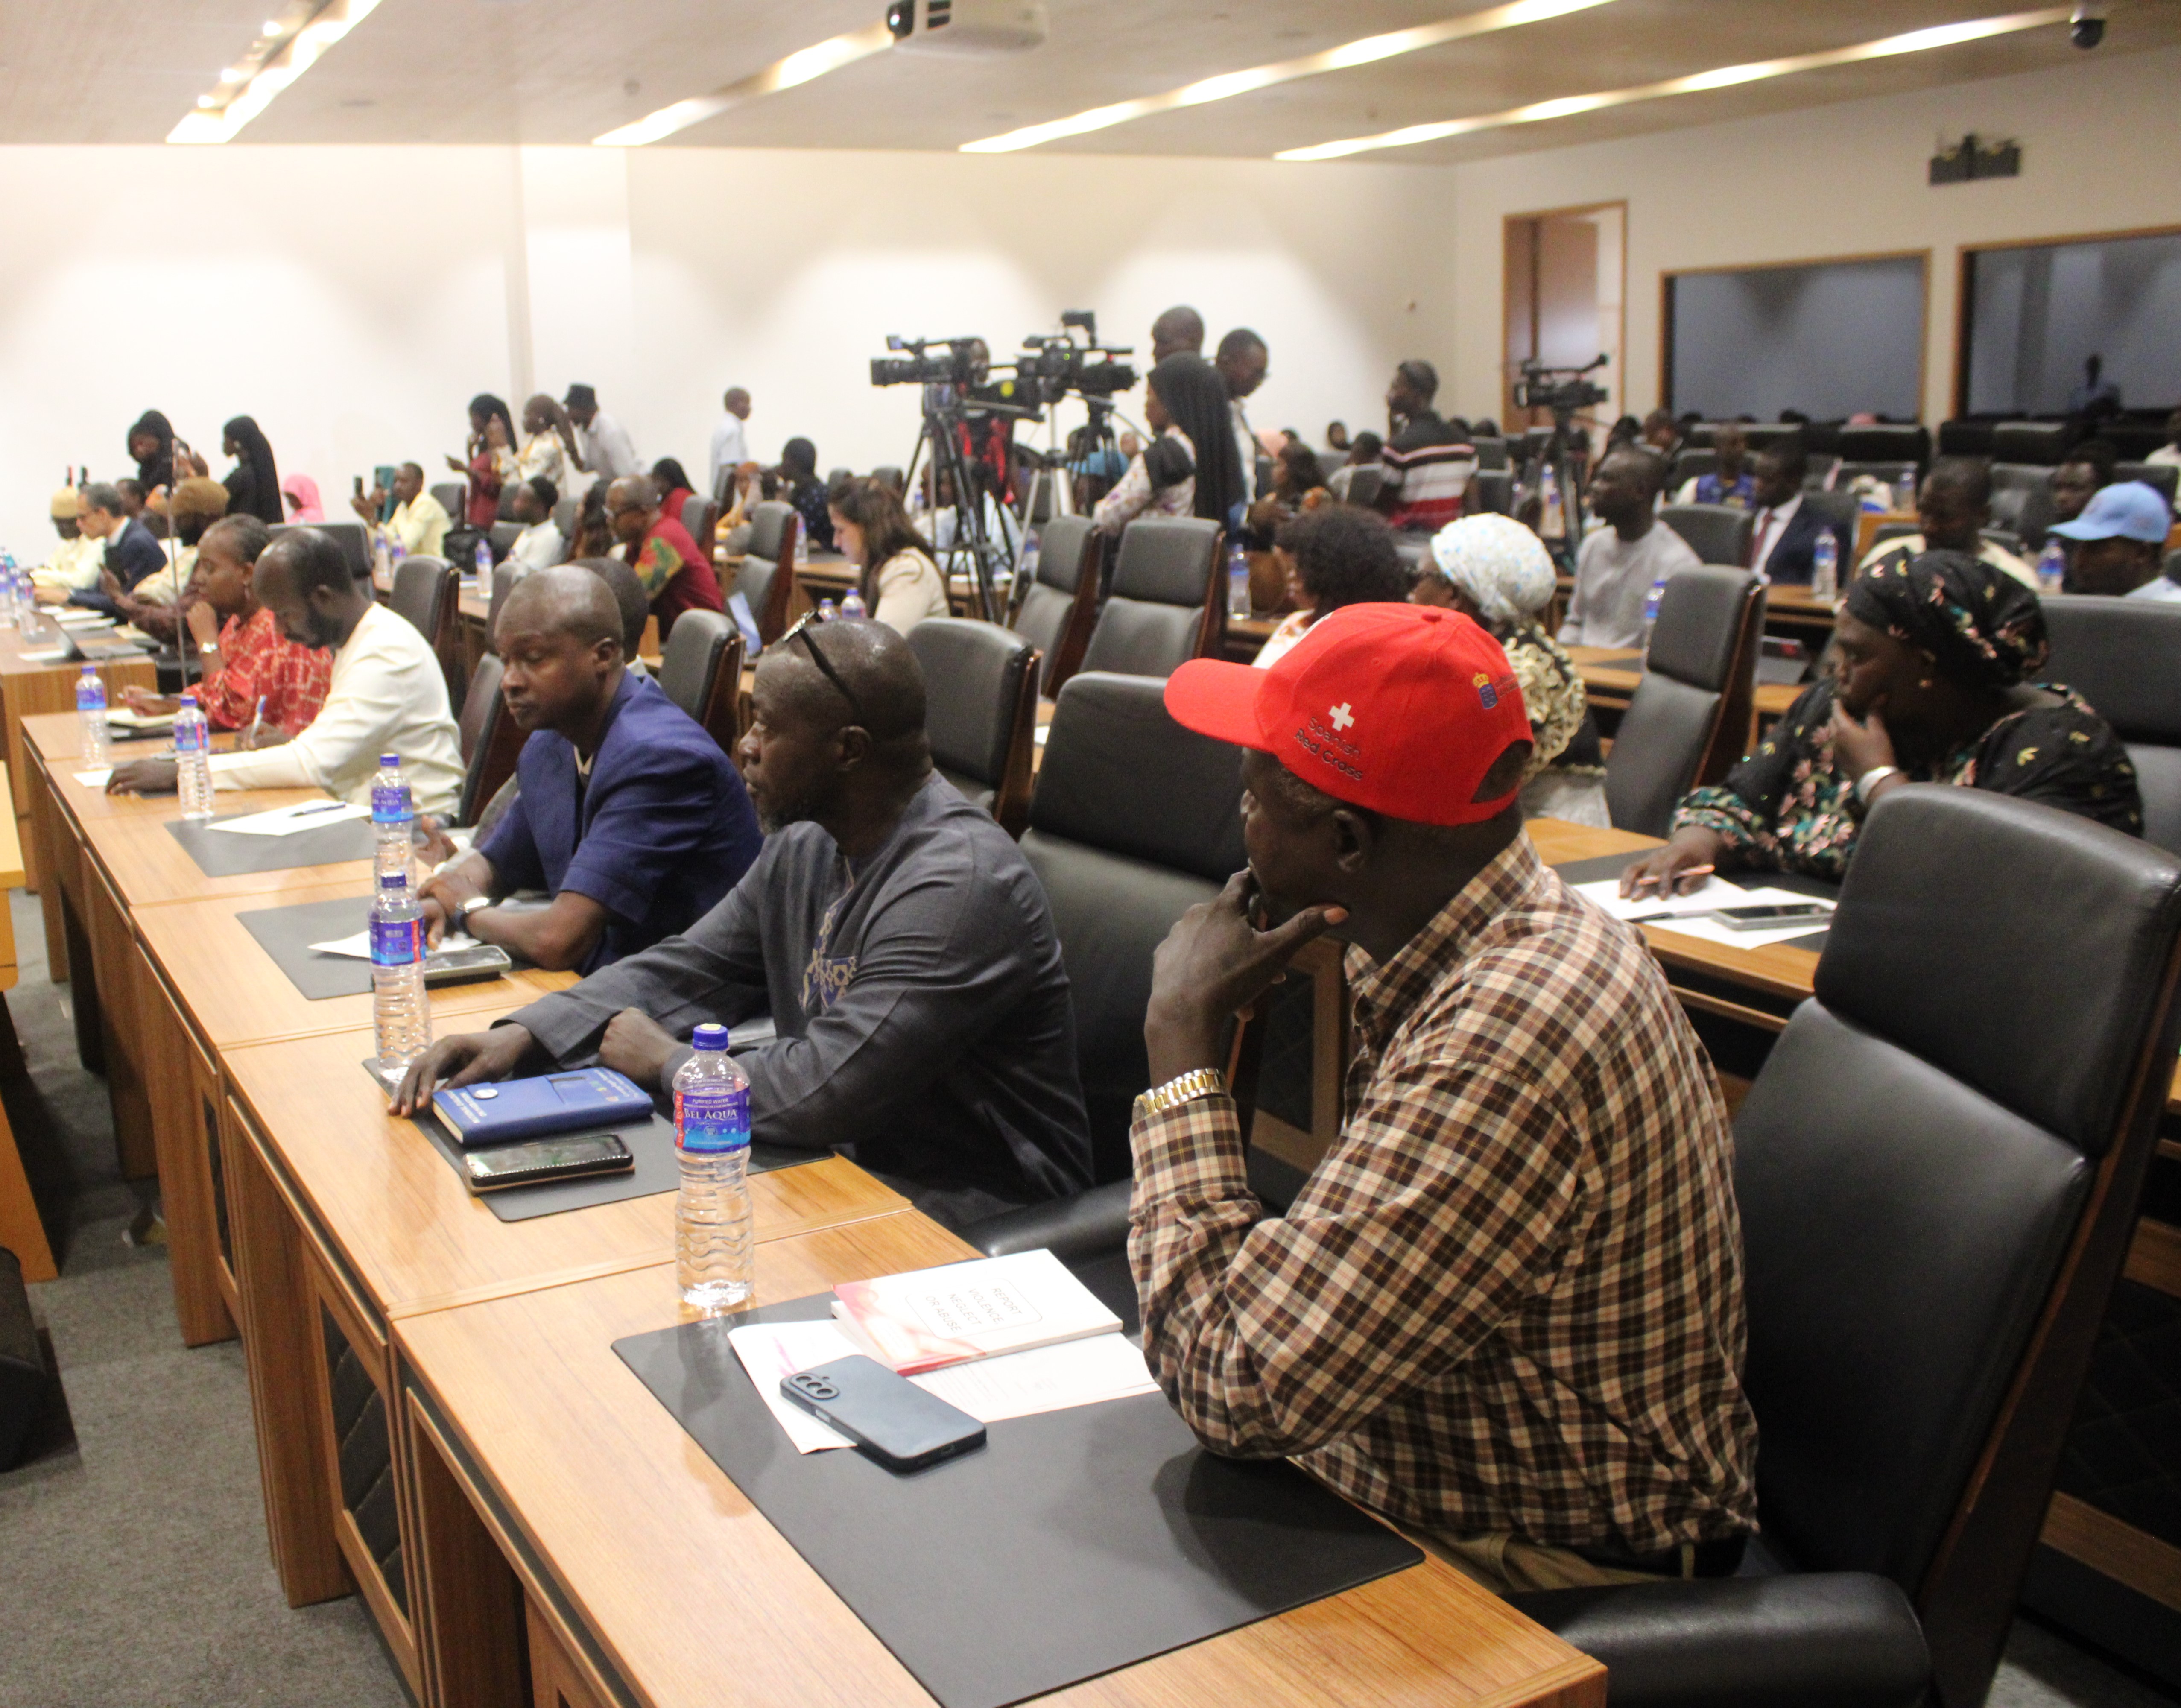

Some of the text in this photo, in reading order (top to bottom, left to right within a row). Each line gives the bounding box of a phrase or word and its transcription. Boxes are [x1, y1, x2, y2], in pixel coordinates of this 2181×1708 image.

[1308, 717, 1360, 760] Spanish
[1294, 728, 1363, 780] Red Cross
[684, 1108, 738, 1121] BEL AQUA
[925, 1295, 941, 1307] OR
[947, 1293, 982, 1325] NEGLECT
[991, 1287, 1023, 1315] REPORT
